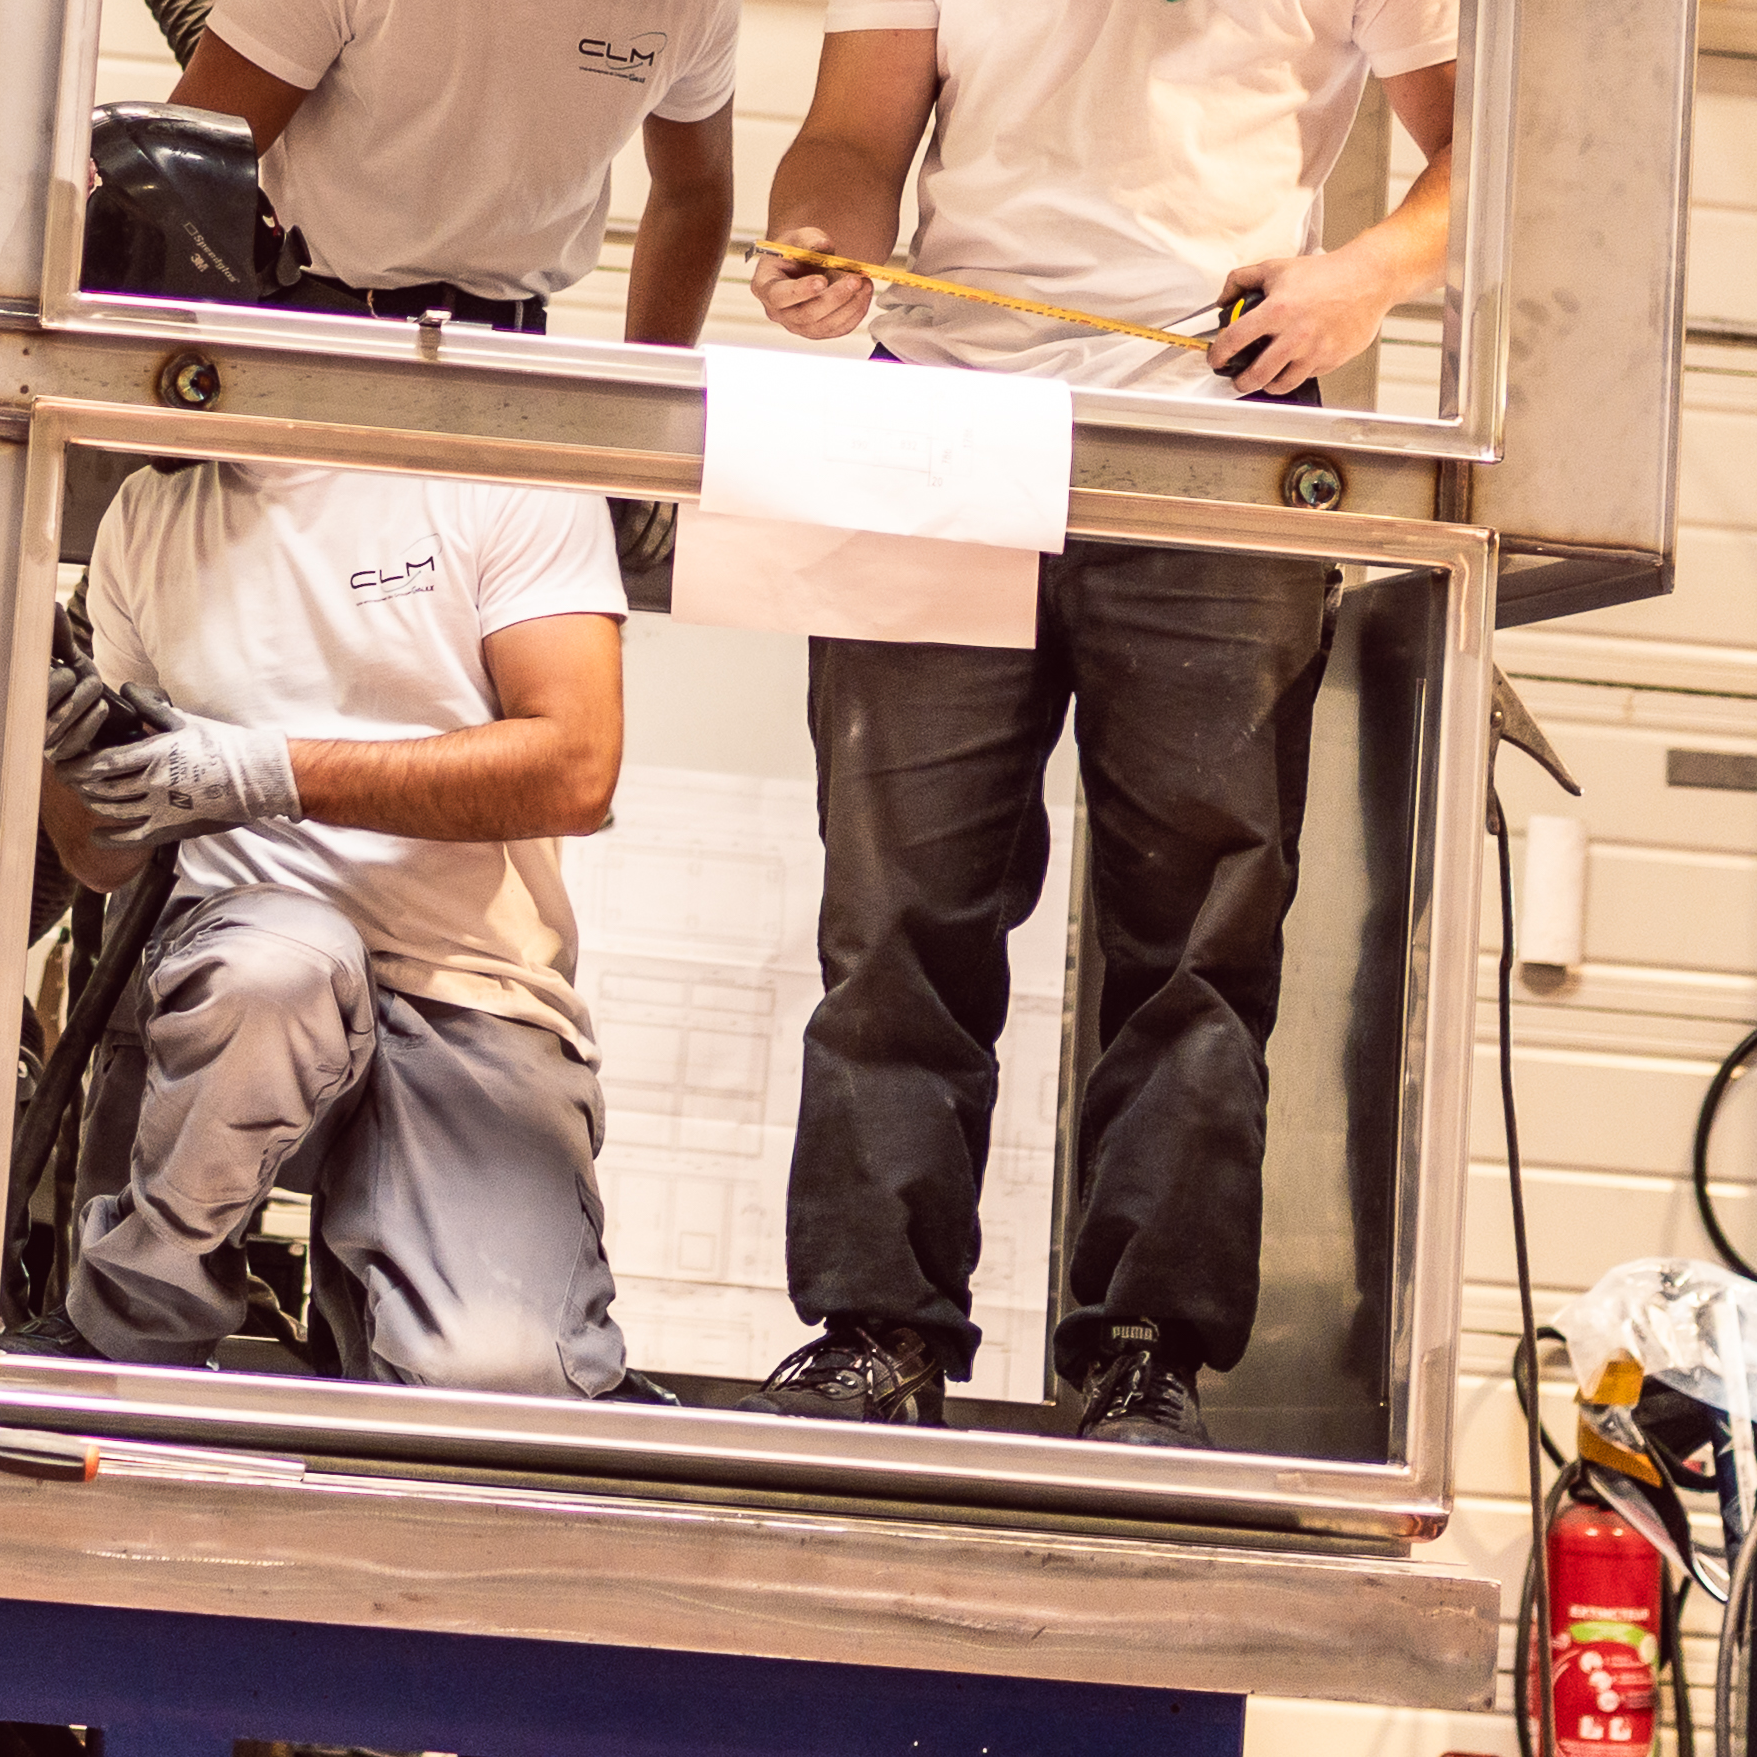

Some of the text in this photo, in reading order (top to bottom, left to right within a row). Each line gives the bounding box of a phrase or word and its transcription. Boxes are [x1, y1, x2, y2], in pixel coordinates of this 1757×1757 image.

[578, 38, 655, 66] CLM
[190, 253, 210, 272] 3M
[931, 475, 944, 487] 20
[350, 555, 435, 590] CLM
